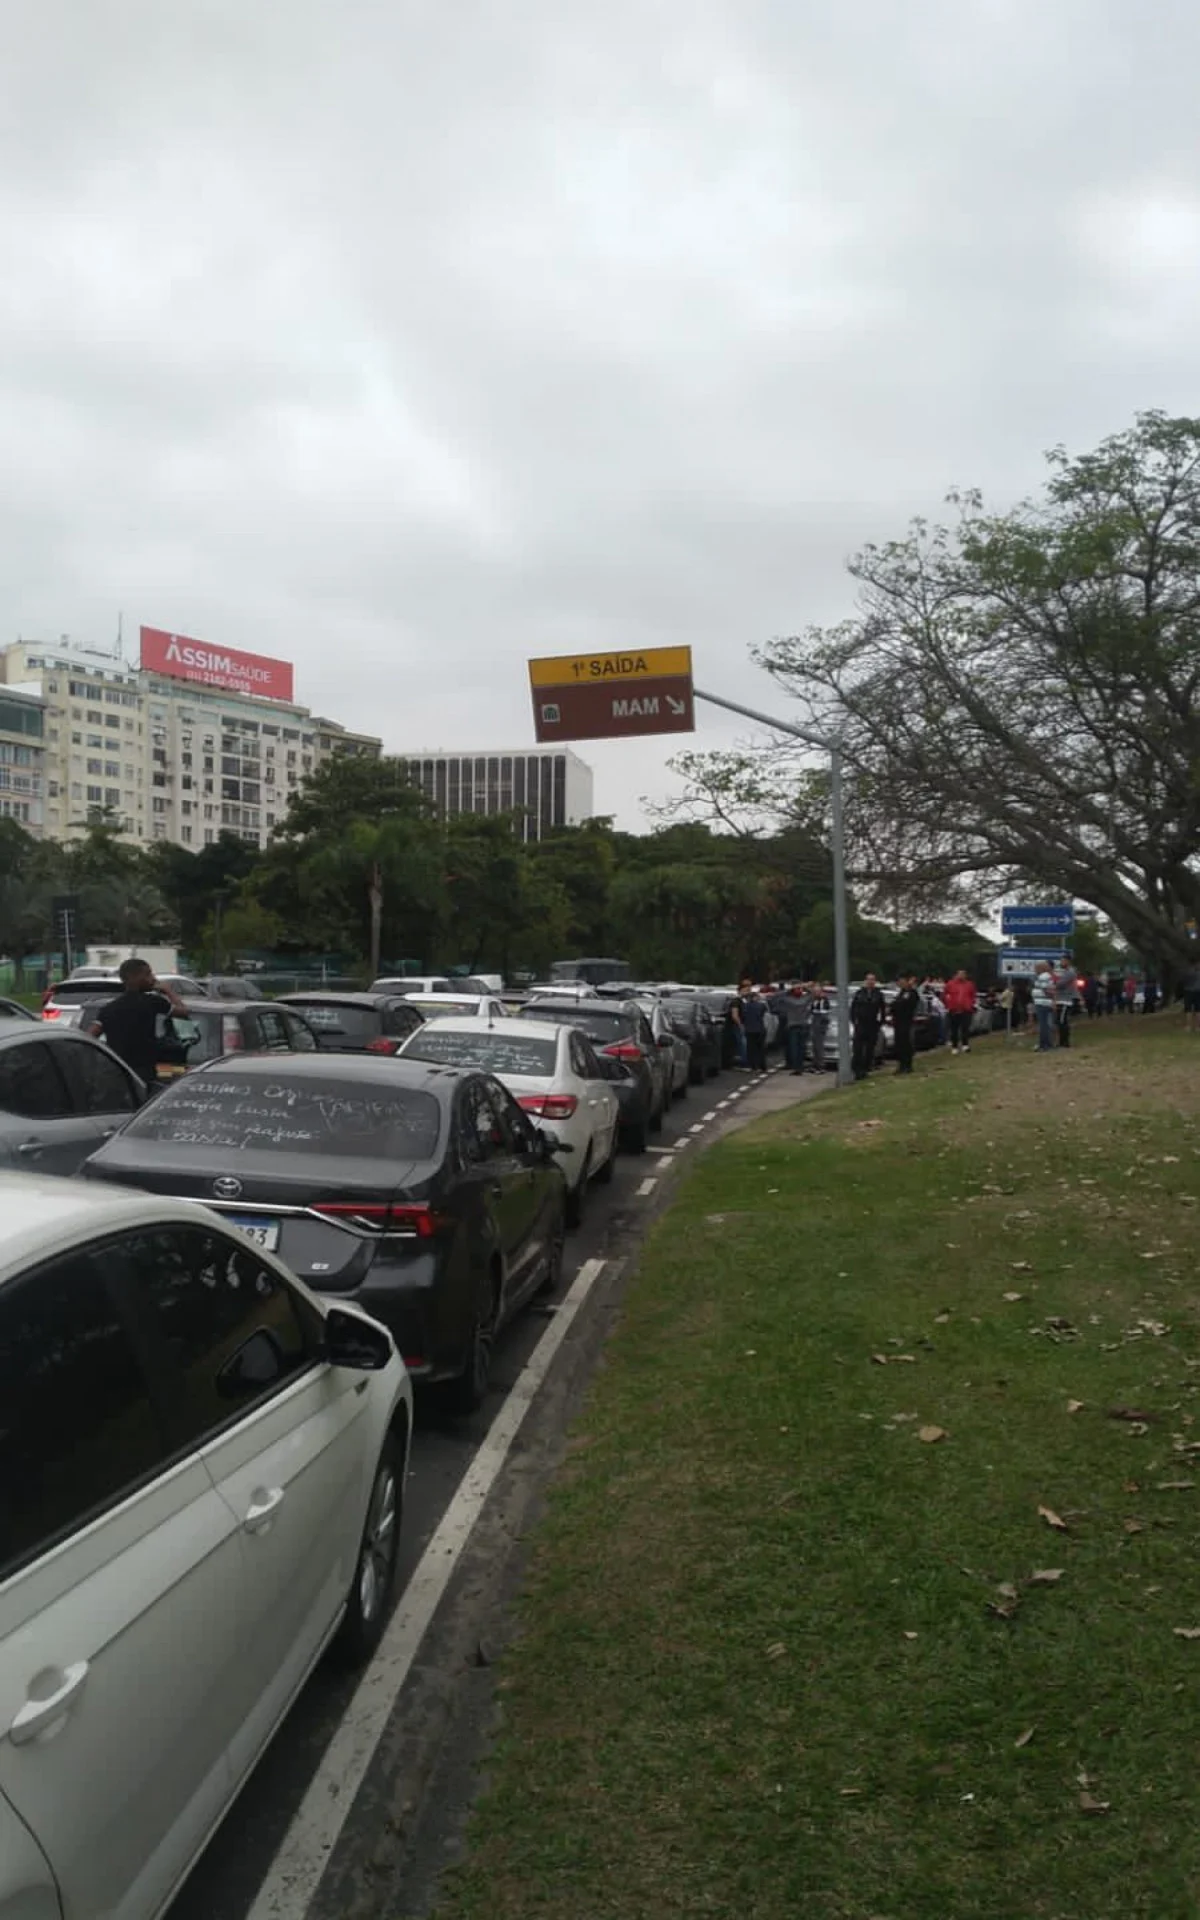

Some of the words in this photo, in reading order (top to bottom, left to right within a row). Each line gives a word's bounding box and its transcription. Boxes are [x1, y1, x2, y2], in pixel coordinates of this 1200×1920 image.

[166, 636, 231, 673] ASSIM
[590, 655, 648, 677] SAÍDA
[612, 696, 660, 717] MAM
